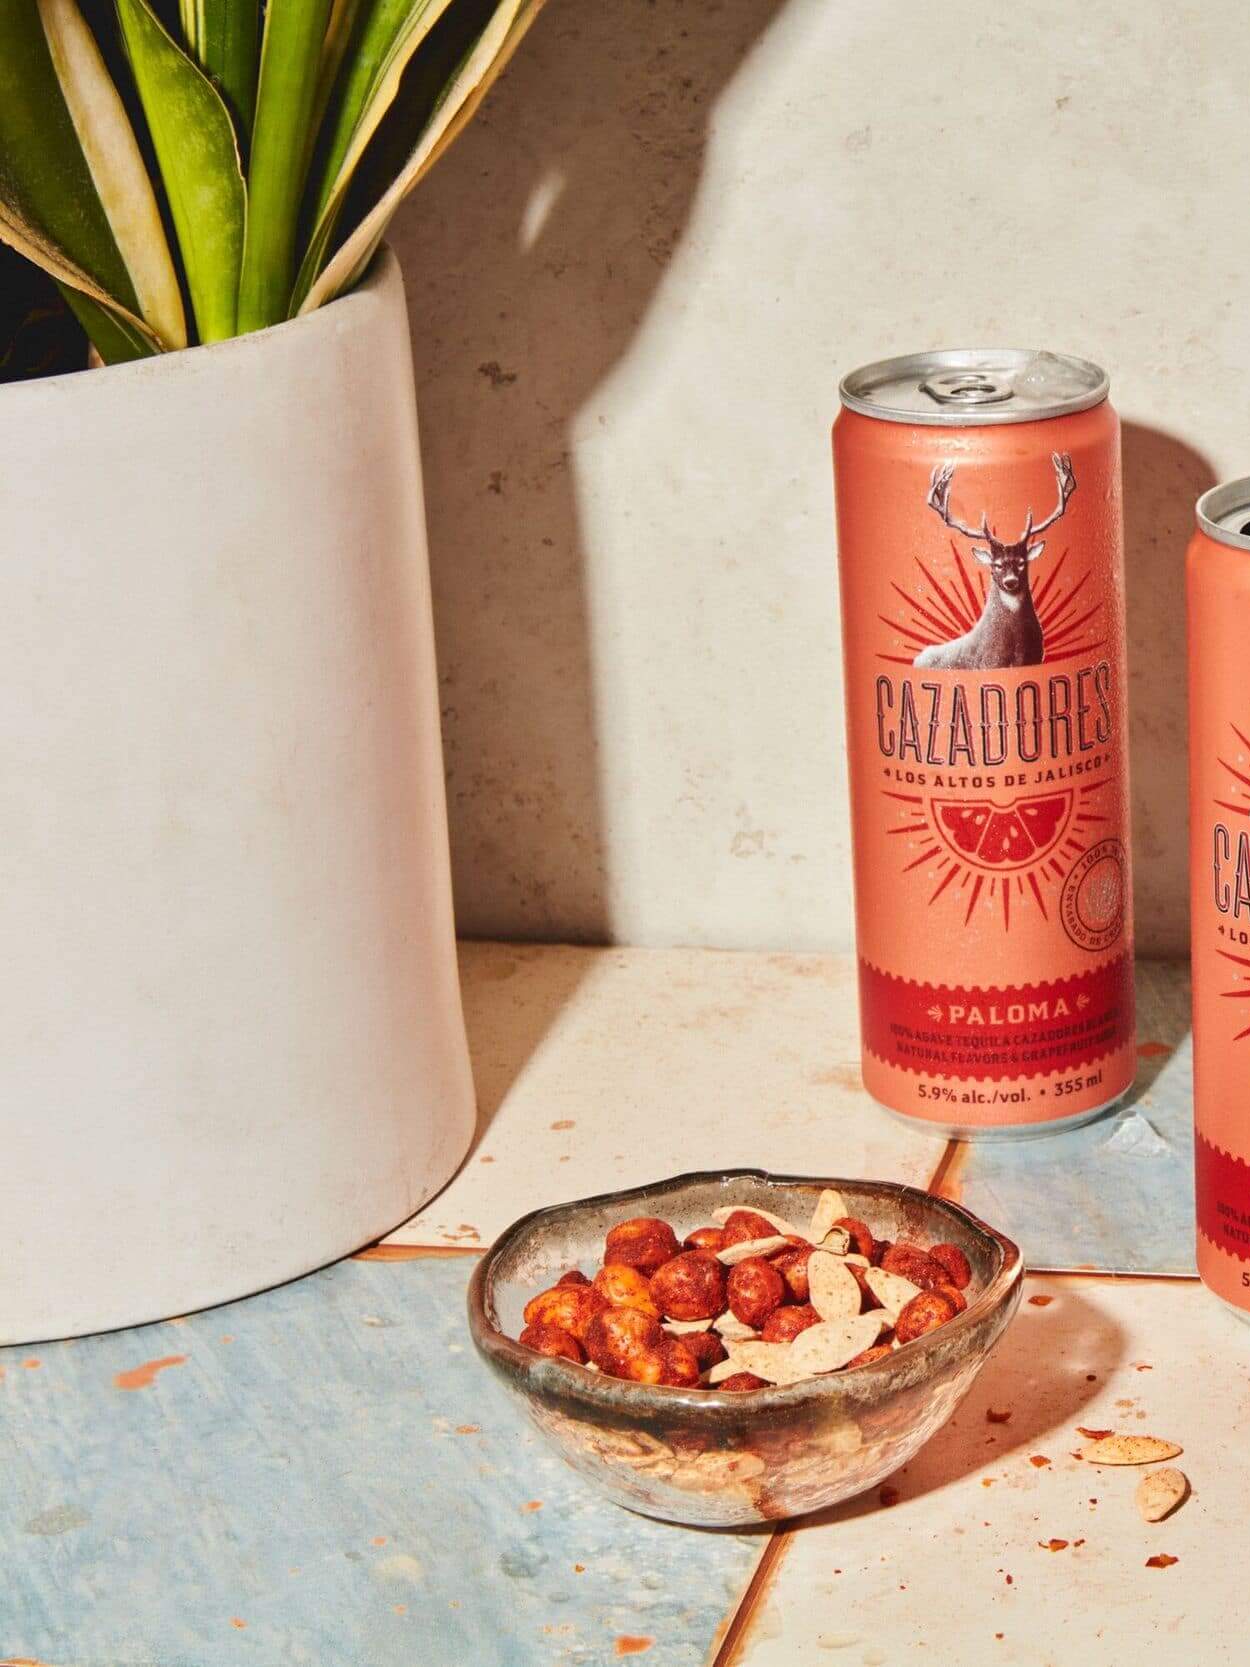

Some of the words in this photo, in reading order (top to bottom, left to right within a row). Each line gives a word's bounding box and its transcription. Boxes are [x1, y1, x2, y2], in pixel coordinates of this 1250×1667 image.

[875, 660, 1112, 766] CAZADORES
[895, 770, 927, 786] LOS
[934, 775, 996, 789] ALTOS
[1004, 773, 1027, 786] DE
[1034, 757, 1102, 784] JALISCO
[949, 997, 1071, 1026] PALOMA
[917, 1084, 957, 1103] 5.9%
[961, 1088, 1031, 1104] alc./vol.
[1054, 1079, 1083, 1097] 355
[1085, 1069, 1102, 1088] ml
